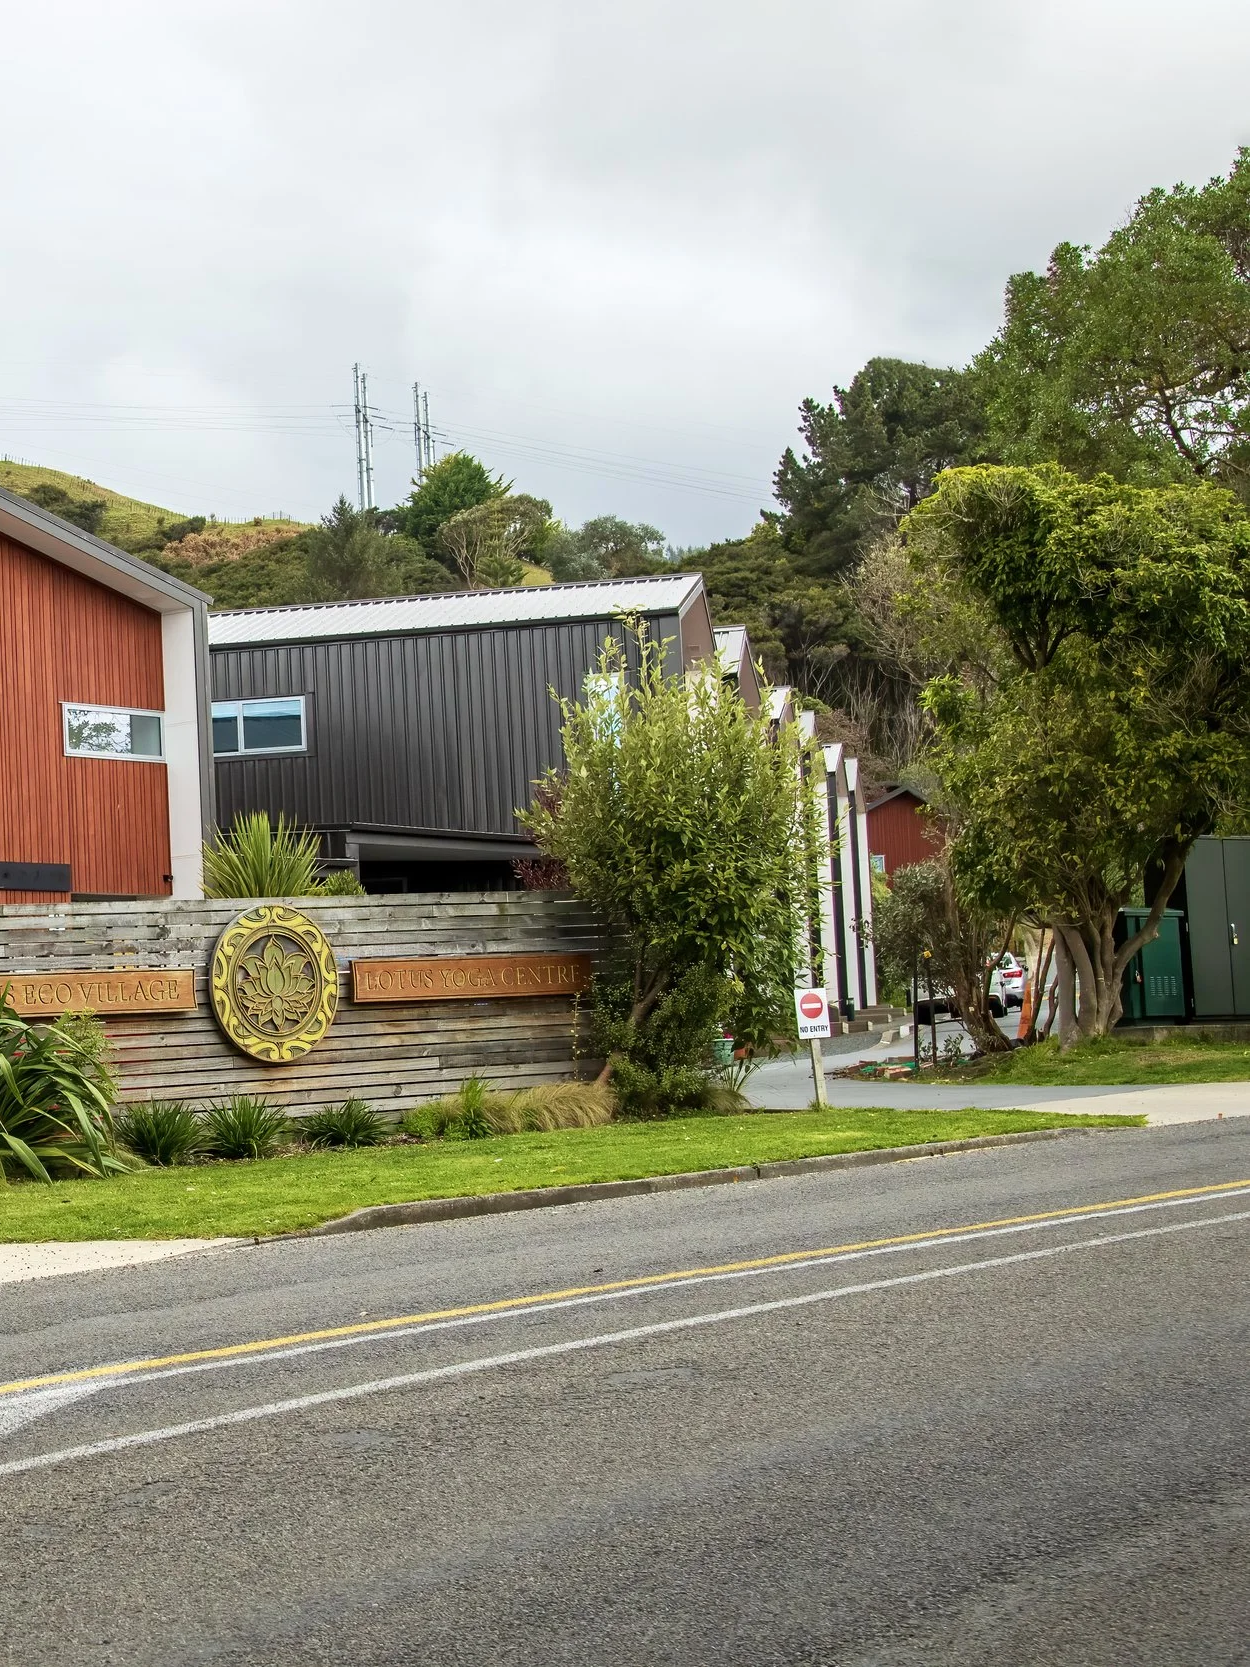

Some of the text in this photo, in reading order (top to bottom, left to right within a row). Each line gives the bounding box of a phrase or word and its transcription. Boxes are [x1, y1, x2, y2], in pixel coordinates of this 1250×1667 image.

[365, 964, 581, 991] LOTUS YOGA CENTRE
[21, 982, 73, 1005] ECO
[77, 979, 180, 1004] VILLAGE
